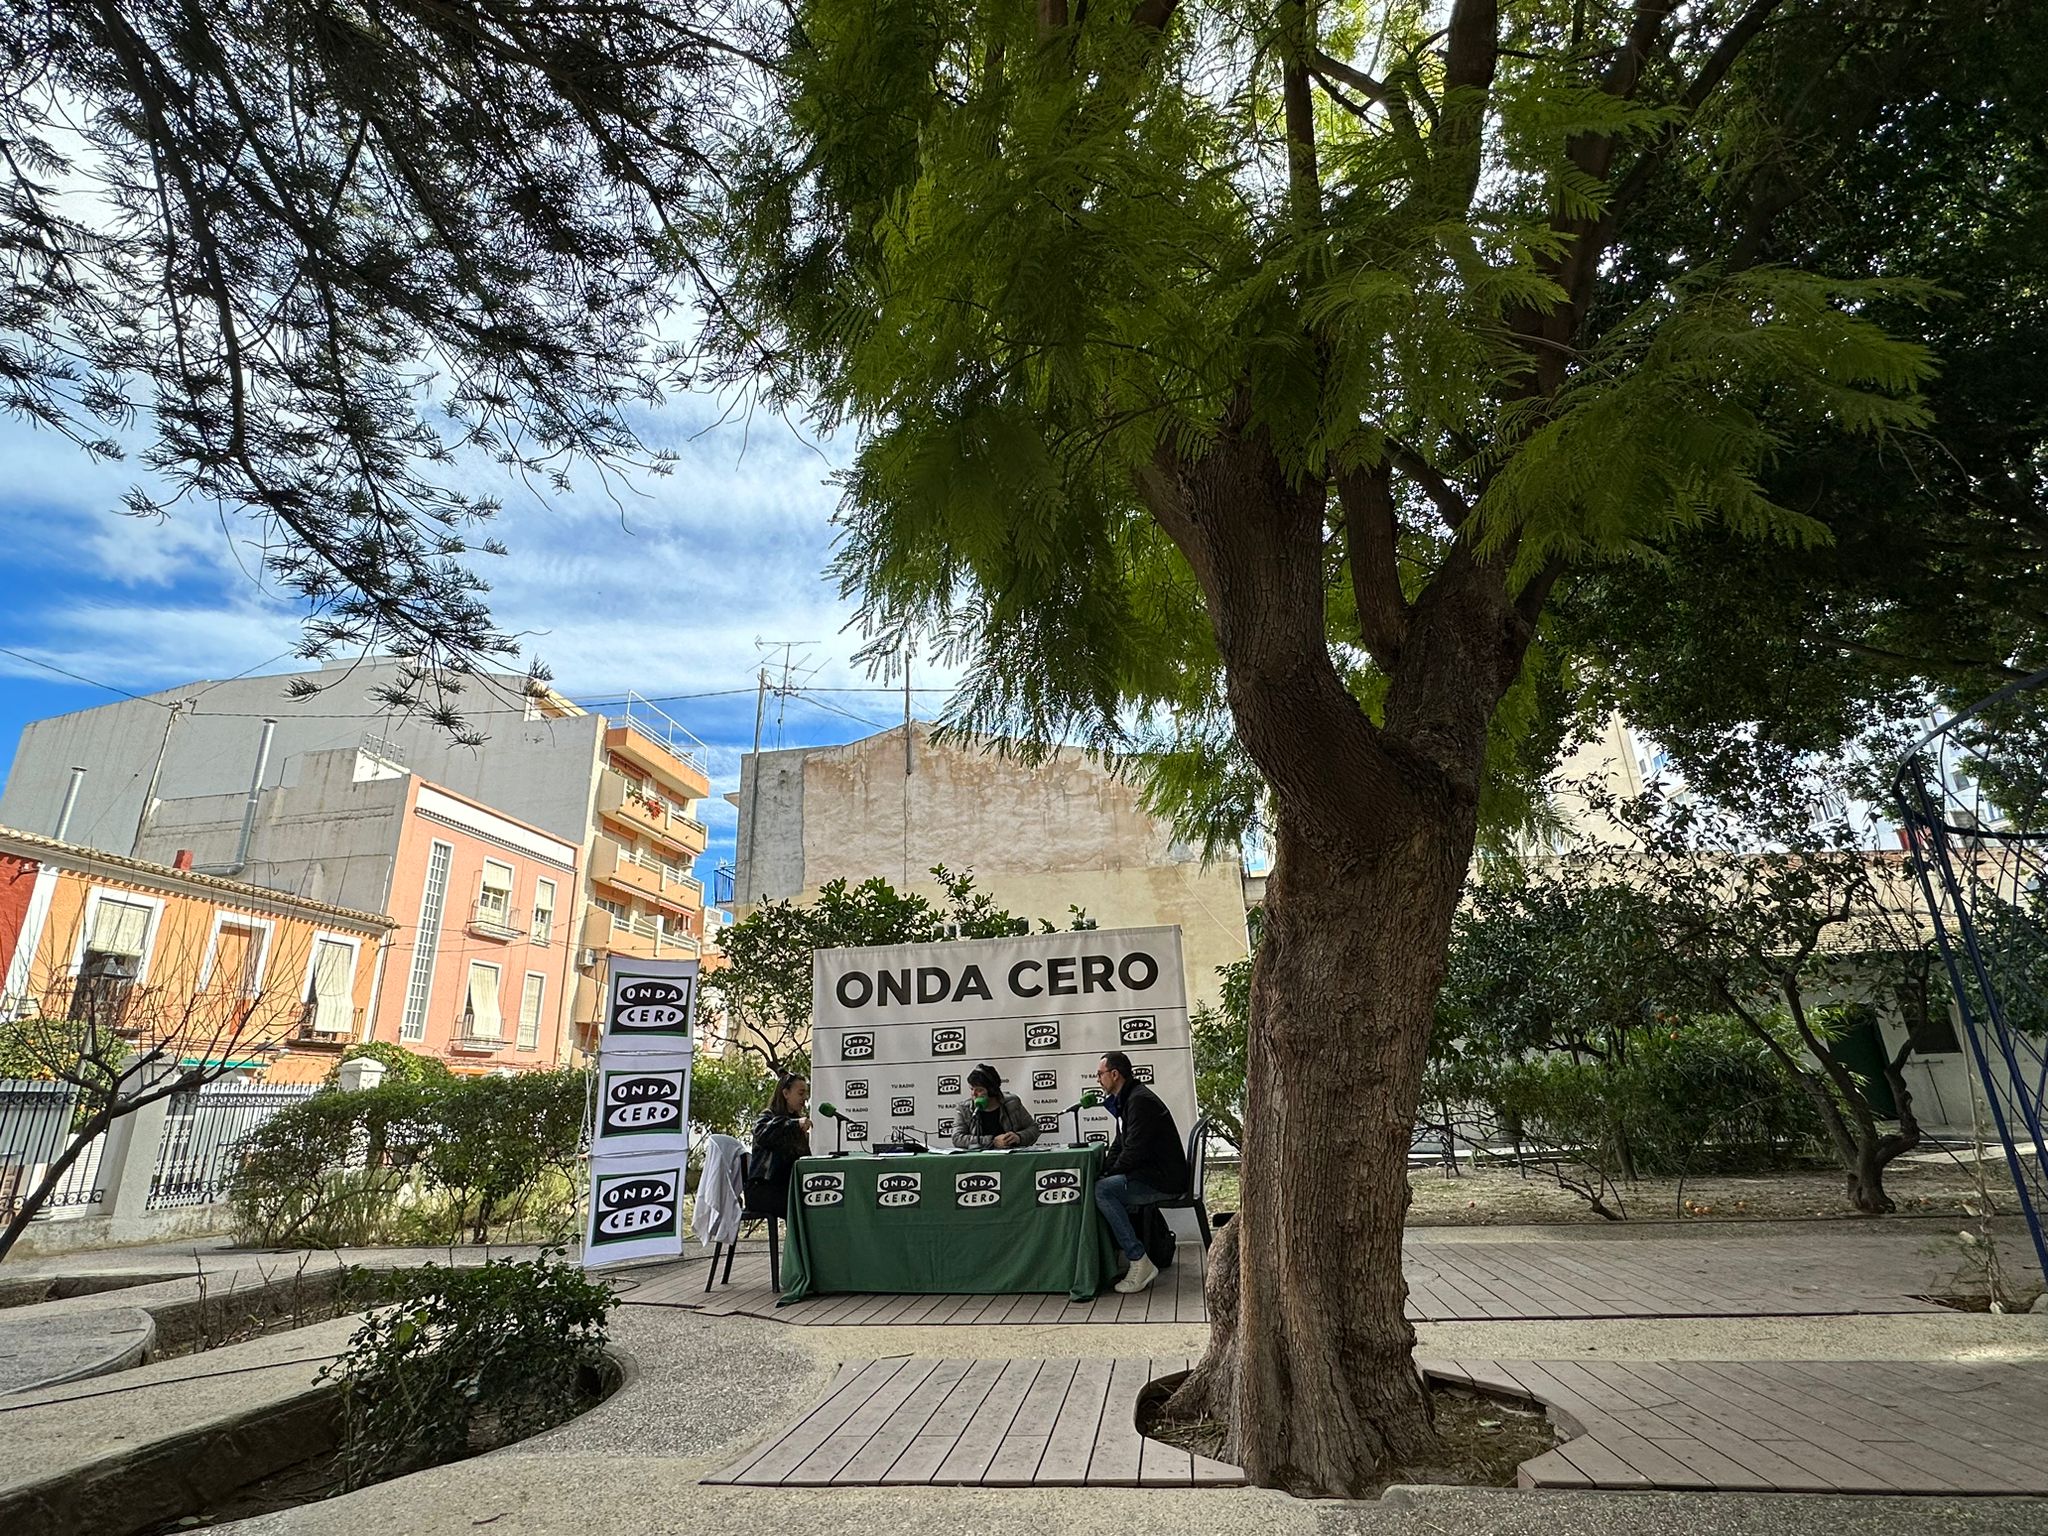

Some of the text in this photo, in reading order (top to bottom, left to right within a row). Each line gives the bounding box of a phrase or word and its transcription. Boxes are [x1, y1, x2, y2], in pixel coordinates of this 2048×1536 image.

[836, 951, 1159, 1009] ONDA CERO
[626, 987, 678, 1001] ONDA
[626, 1008, 677, 1024] CERO
[1125, 1021, 1150, 1030] ONDA
[1030, 1027, 1054, 1035] ONDA
[1126, 1031, 1151, 1040] CERO
[936, 1032, 961, 1041] ONDA
[1032, 1037, 1054, 1045] CERO
[847, 1037, 870, 1046] ONDA
[938, 1042, 961, 1051] CERO
[848, 1047, 869, 1056] CERO
[617, 1083, 671, 1098] ONDA
[617, 1105, 670, 1122] CERO
[806, 1179, 839, 1188] ONDA
[883, 1180, 915, 1188] ONDA
[961, 1179, 995, 1188] ONDA
[1041, 1176, 1075, 1186] ONDA
[609, 1184, 665, 1201] ONDA
[1044, 1191, 1075, 1201] CERO
[807, 1193, 838, 1203] CERO
[884, 1194, 915, 1203] CERO
[963, 1193, 995, 1203] CERO
[610, 1208, 664, 1228] CERO
